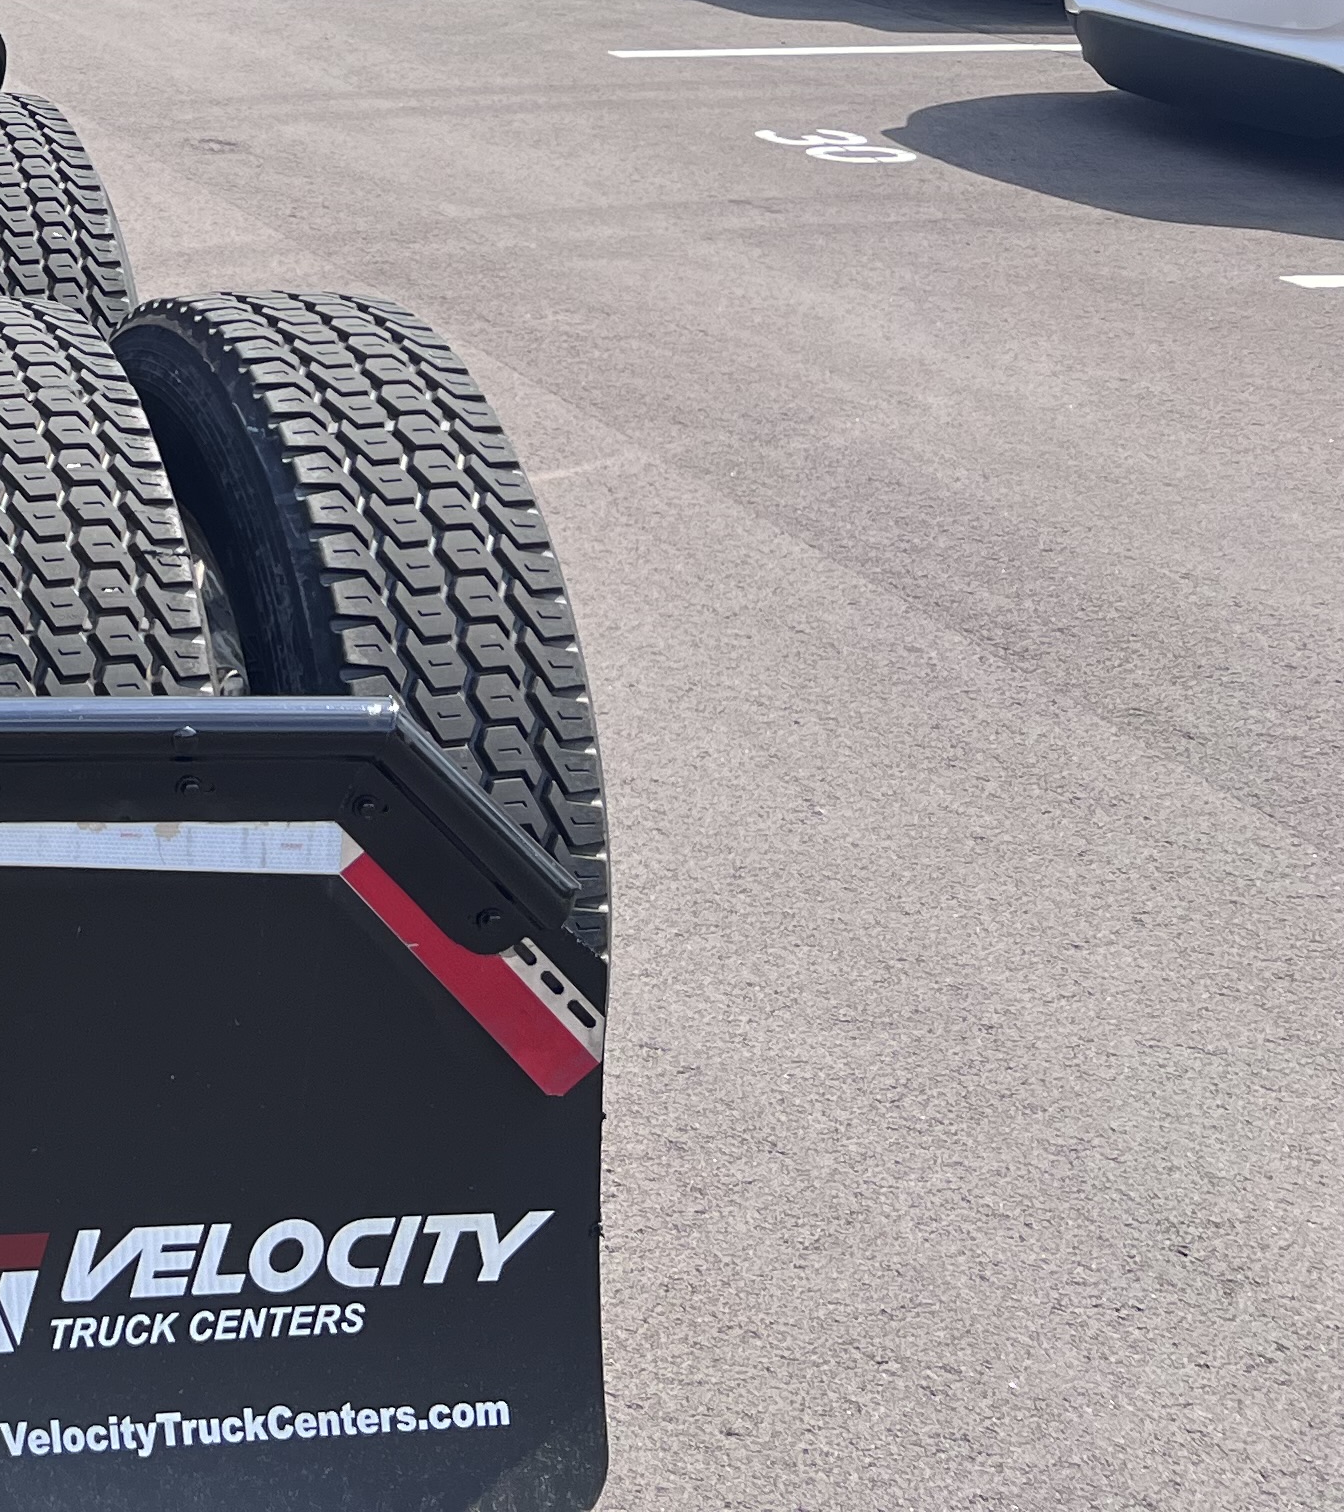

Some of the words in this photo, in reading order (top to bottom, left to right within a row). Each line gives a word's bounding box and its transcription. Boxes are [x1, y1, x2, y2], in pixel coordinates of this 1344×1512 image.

[754, 128, 917, 164] 30
[60, 1210, 556, 1304] VELOCITY
[50, 1311, 177, 1350] TRUCK
[189, 1301, 366, 1343] CENTERS
